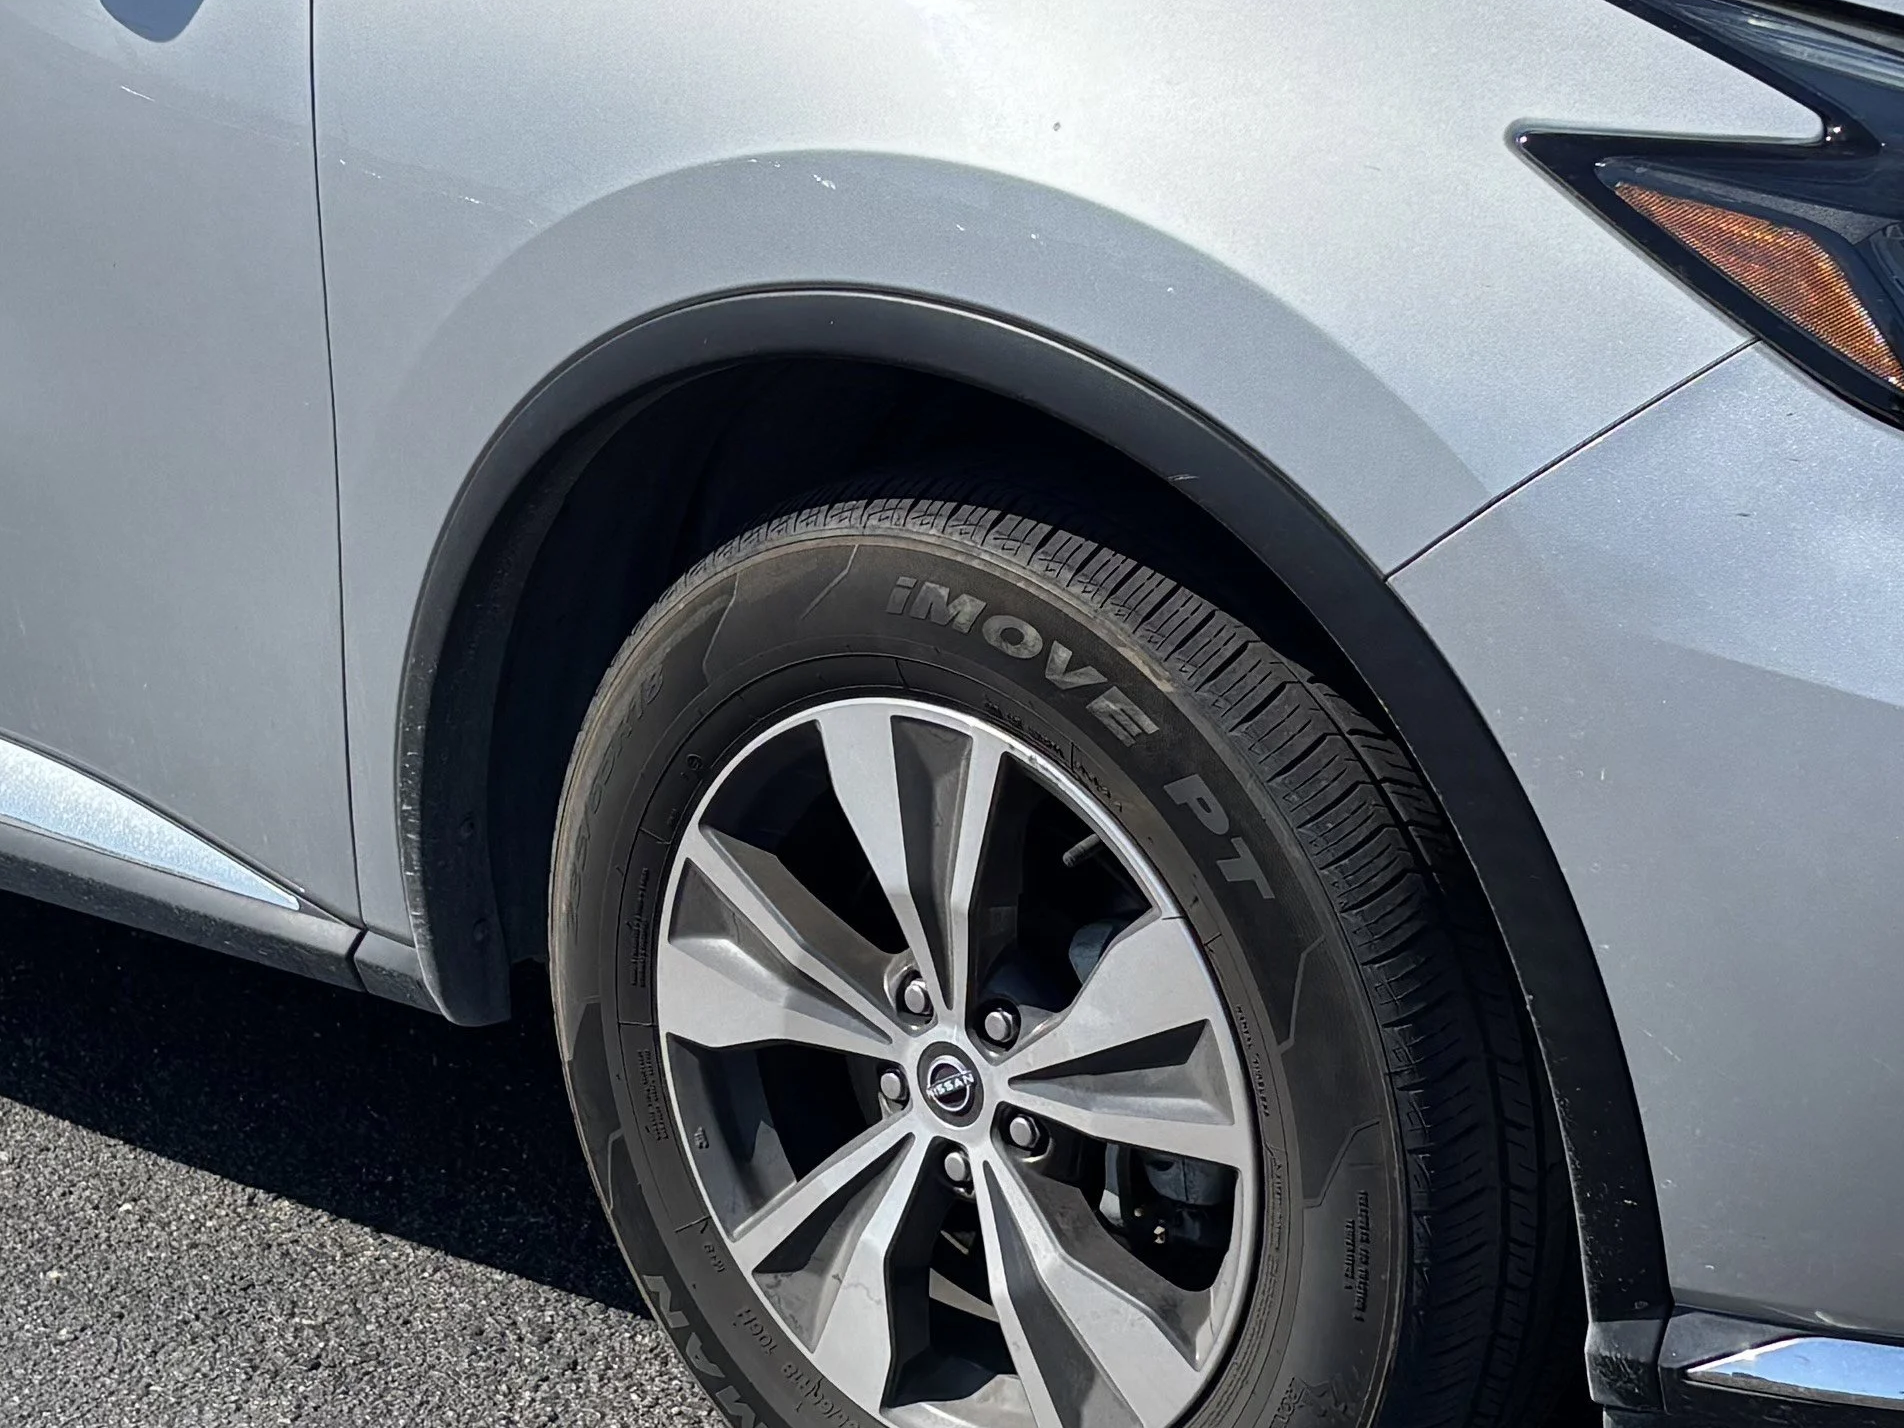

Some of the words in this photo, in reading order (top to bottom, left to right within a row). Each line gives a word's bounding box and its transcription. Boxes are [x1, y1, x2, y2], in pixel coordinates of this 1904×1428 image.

[884, 574, 1160, 746] iMOVE
[1165, 771, 1277, 903] PT
[926, 1072, 975, 1099] NISSAN
